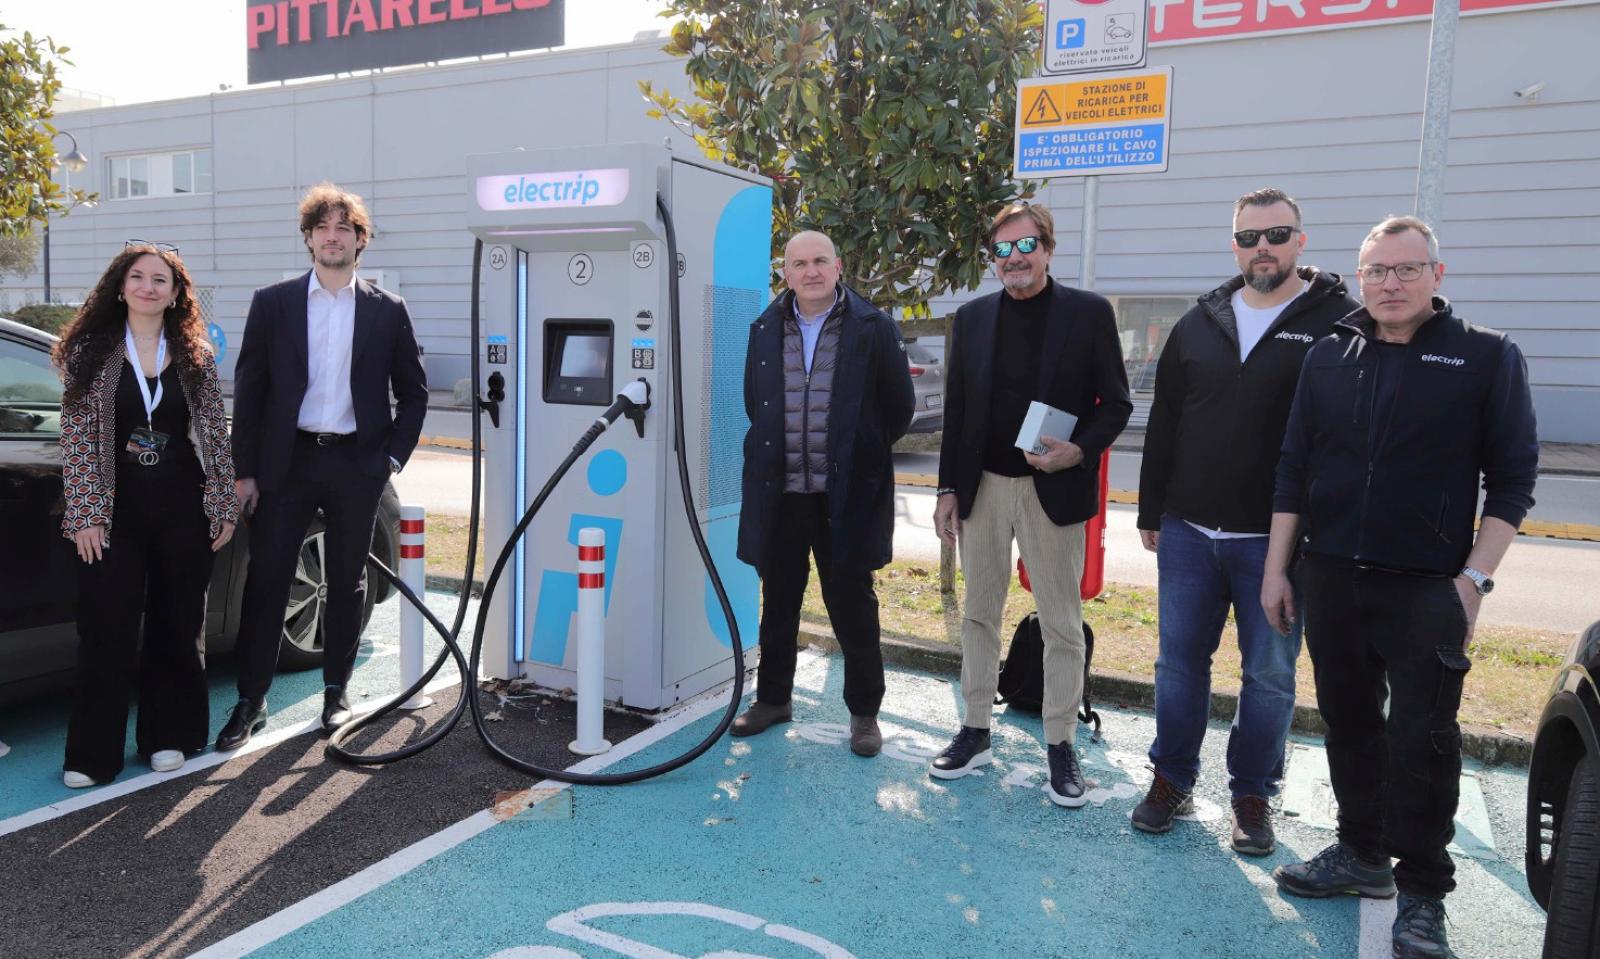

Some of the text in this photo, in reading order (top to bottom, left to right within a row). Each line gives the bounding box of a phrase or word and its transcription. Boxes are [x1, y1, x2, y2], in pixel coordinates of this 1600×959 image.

[247, 0, 551, 49] PITTARE
[1062, 24, 1079, 46] P
[1082, 81, 1146, 95] STAZIONE DI
[1077, 93, 1149, 107] RICARICA PER
[1066, 104, 1162, 120] VEICOLI ELETTRICI
[1038, 129, 1143, 144] E' OBBLIGATORIO
[1024, 139, 1157, 157] ISPEZIONARE IL CAVO
[1024, 152, 1155, 168] PRIMA DELL'UTILIZZO
[504, 173, 599, 205] electrip
[492, 253, 505, 265] 2A
[636, 251, 650, 262] 2B
[575, 260, 586, 279] 2
[1421, 354, 1465, 366] electrip
